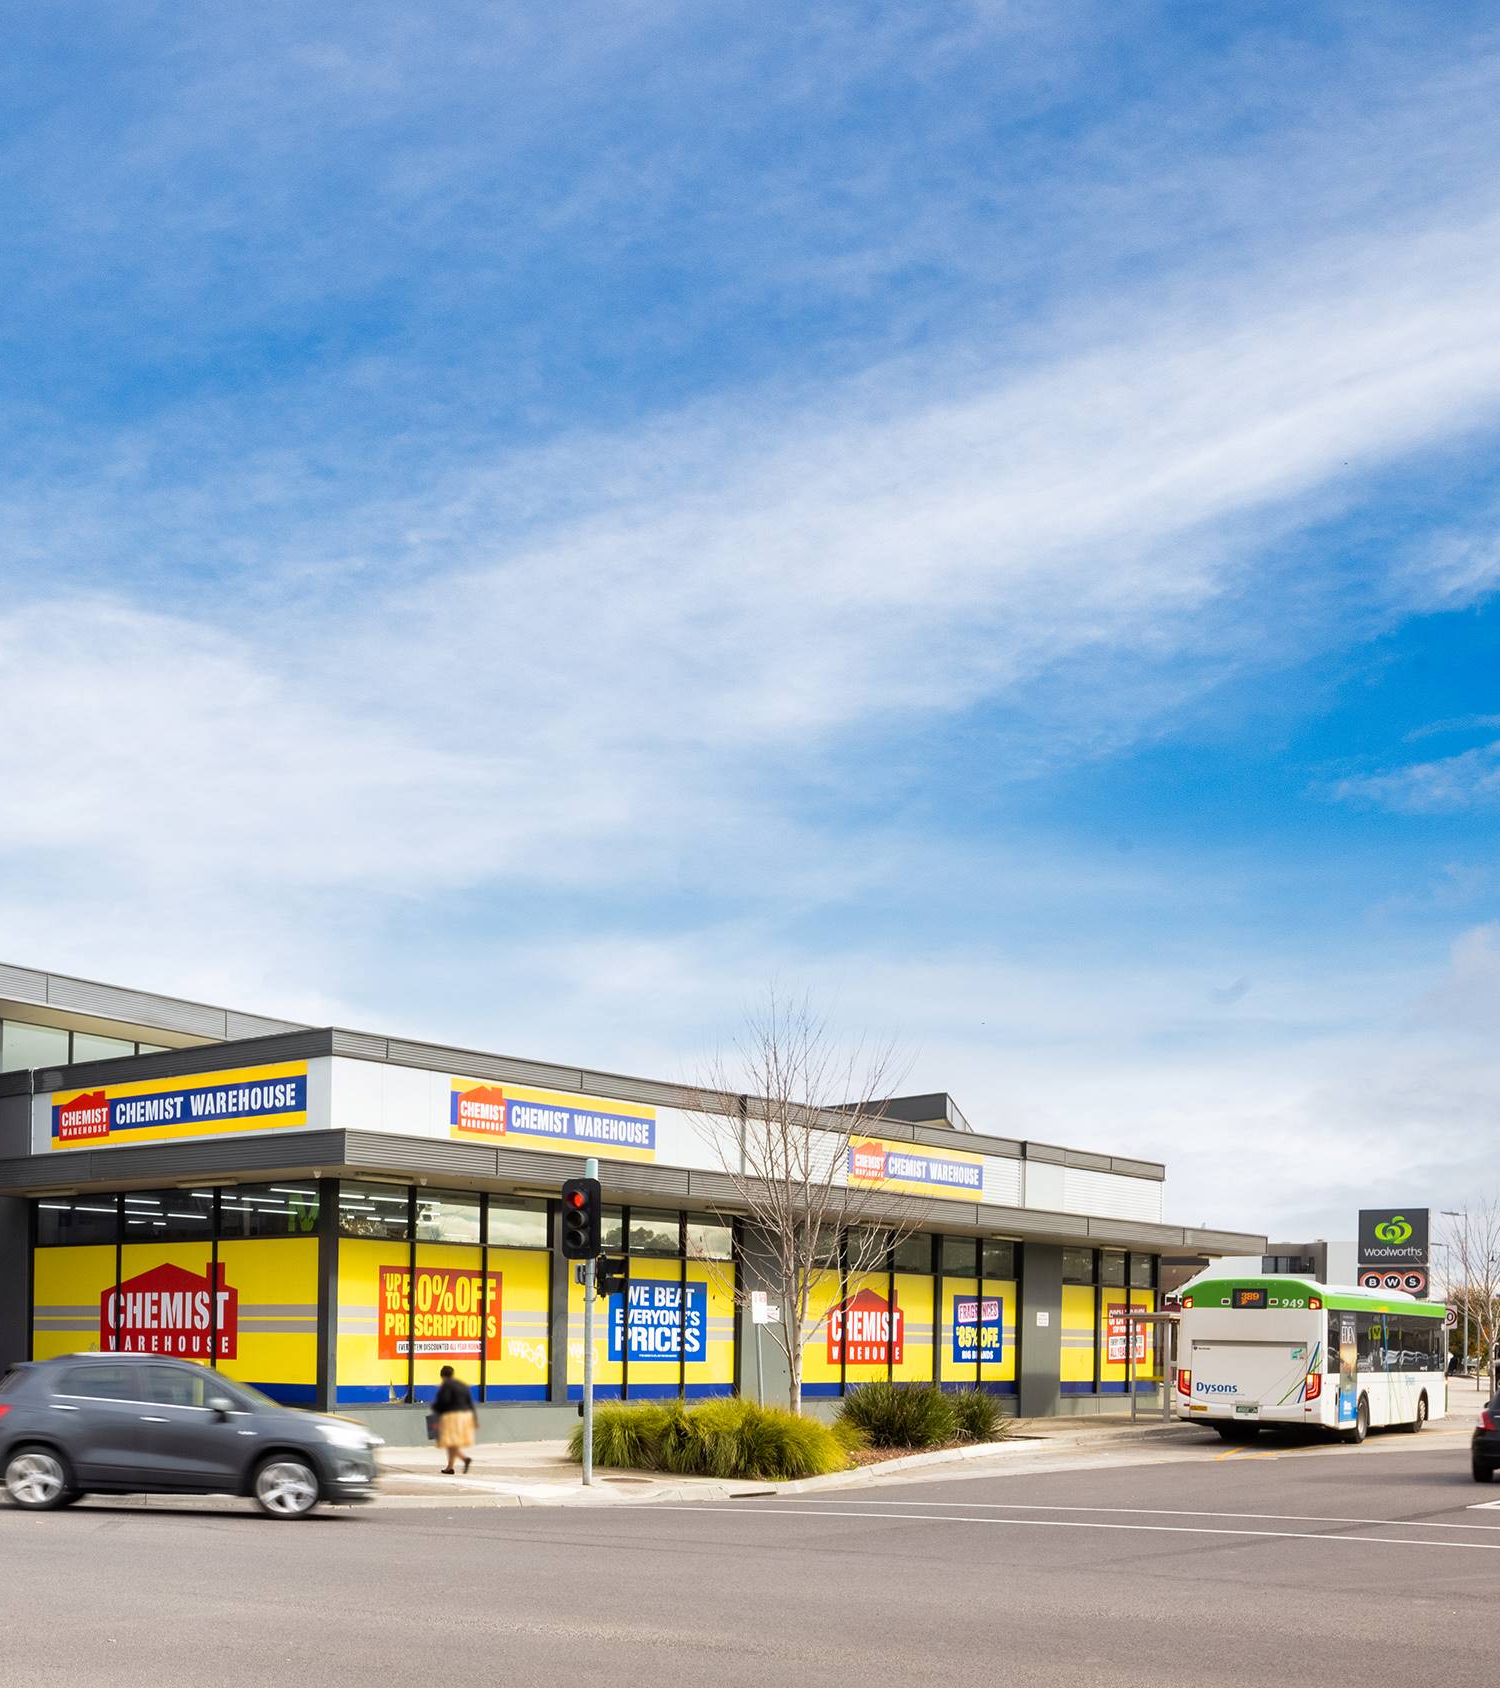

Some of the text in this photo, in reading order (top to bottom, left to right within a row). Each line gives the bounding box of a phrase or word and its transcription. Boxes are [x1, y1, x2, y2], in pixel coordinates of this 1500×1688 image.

[115, 1083, 296, 1125] CHEMIST WAREHOUSE
[460, 1100, 505, 1121] CHEMIST
[61, 1107, 108, 1128] CHEMIST
[461, 1119, 504, 1132] WAREHOUSE
[511, 1105, 649, 1145] CHEMIST WAREHOUSE
[62, 1124, 107, 1137] WAREHOUSE
[855, 1154, 884, 1170] CHEMIST
[888, 1156, 979, 1185] CHEMIST WAREHOUSE
[1364, 1246, 1423, 1257] Woolworths
[385, 1291, 401, 1311] TO
[402, 1273, 497, 1313] 50% OFF
[628, 1286, 695, 1309] WE BEAT
[108, 1290, 229, 1330] CHEMIST
[959, 1302, 998, 1320] FRAGRNCES
[1282, 1298, 1304, 1308] 949
[108, 1335, 229, 1353] WAREHOUSE
[398, 1343, 413, 1351] EVER
[414, 1343, 423, 1351] TEM
[614, 1326, 701, 1353] PRICES
[832, 1346, 900, 1360] WREHOUE
[1196, 1381, 1238, 1394] Dysons
